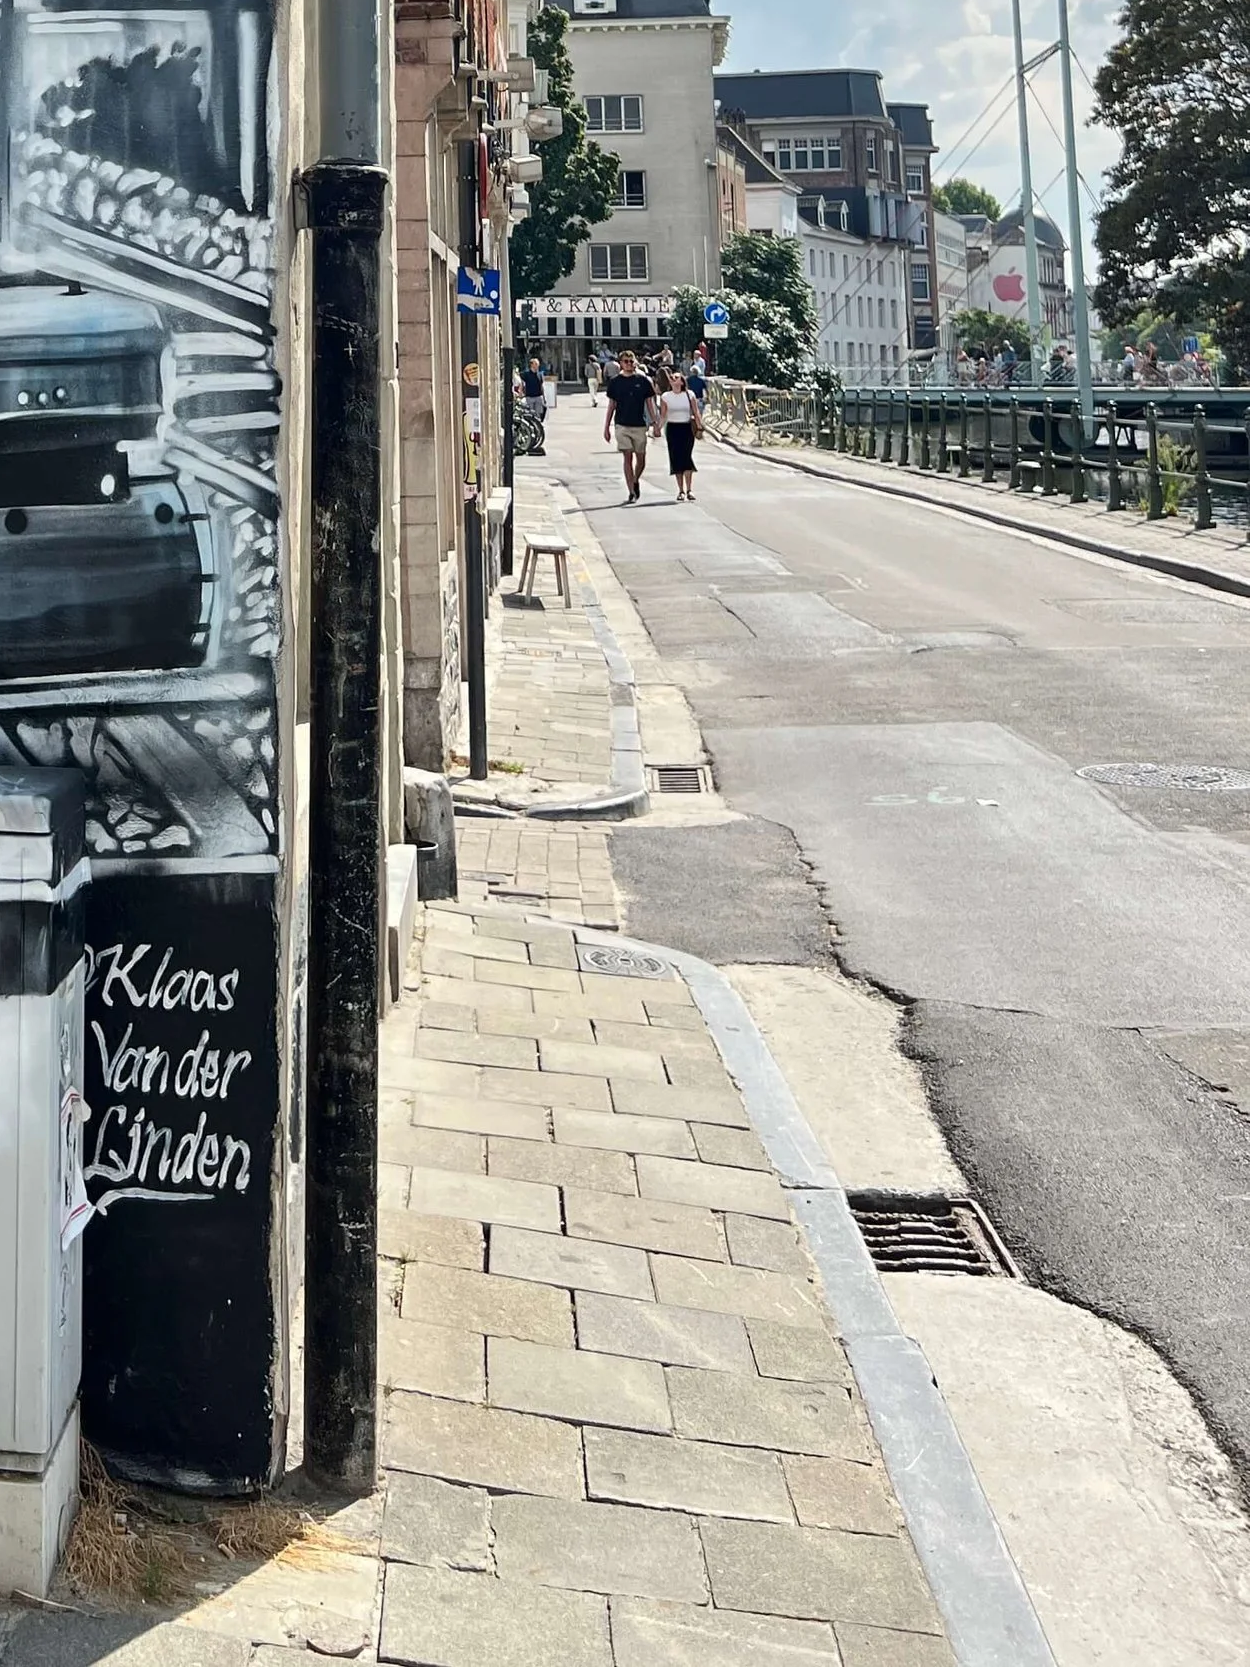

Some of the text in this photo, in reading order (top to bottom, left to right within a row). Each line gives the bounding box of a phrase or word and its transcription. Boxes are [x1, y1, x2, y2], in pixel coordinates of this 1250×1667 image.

[546, 298, 562, 313] &
[568, 298, 670, 314] KAMILLE
[96, 943, 240, 1012] Klaas
[83, 1104, 251, 1191] Linden
